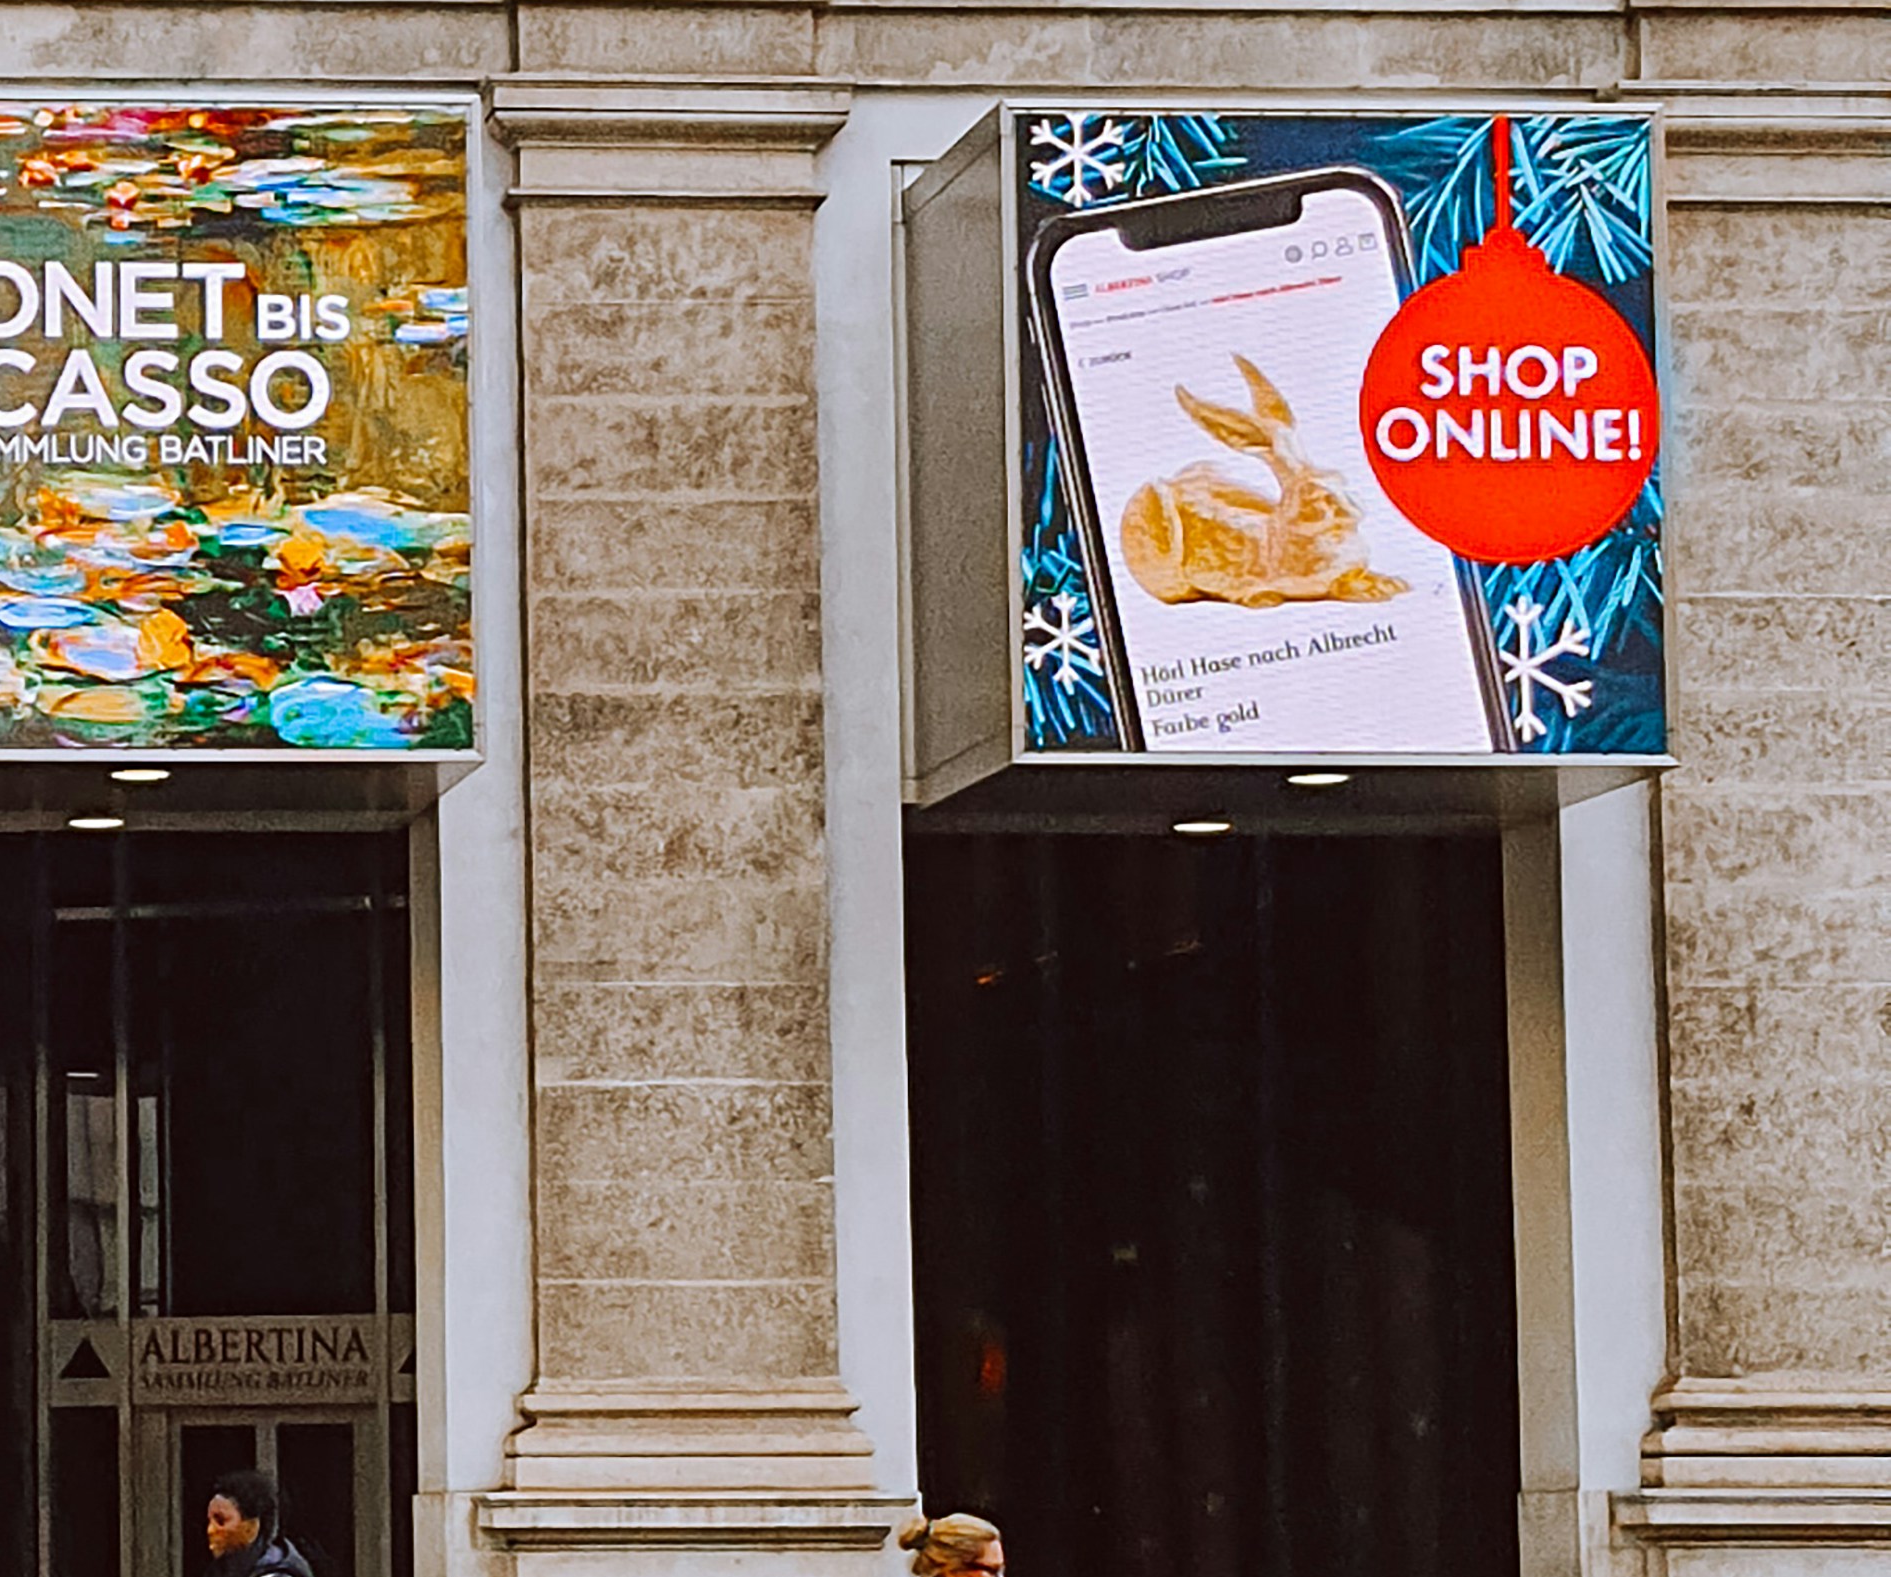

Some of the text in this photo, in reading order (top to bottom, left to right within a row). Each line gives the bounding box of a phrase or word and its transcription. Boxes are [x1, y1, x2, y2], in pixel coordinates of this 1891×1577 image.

[257, 293, 351, 341] BIS
[1420, 344, 1599, 399] SHOP
[160, 434, 328, 466] BATLINER
[1374, 406, 1643, 463] ONLINE!
[1190, 653, 1242, 676] Hase
[1248, 640, 1301, 667] nach
[1308, 624, 1398, 657] Albrecht
[1145, 685, 1205, 708] Dürer
[1151, 700, 1261, 737] Farbe gold
[138, 1326, 371, 1366] ALBERTINA
